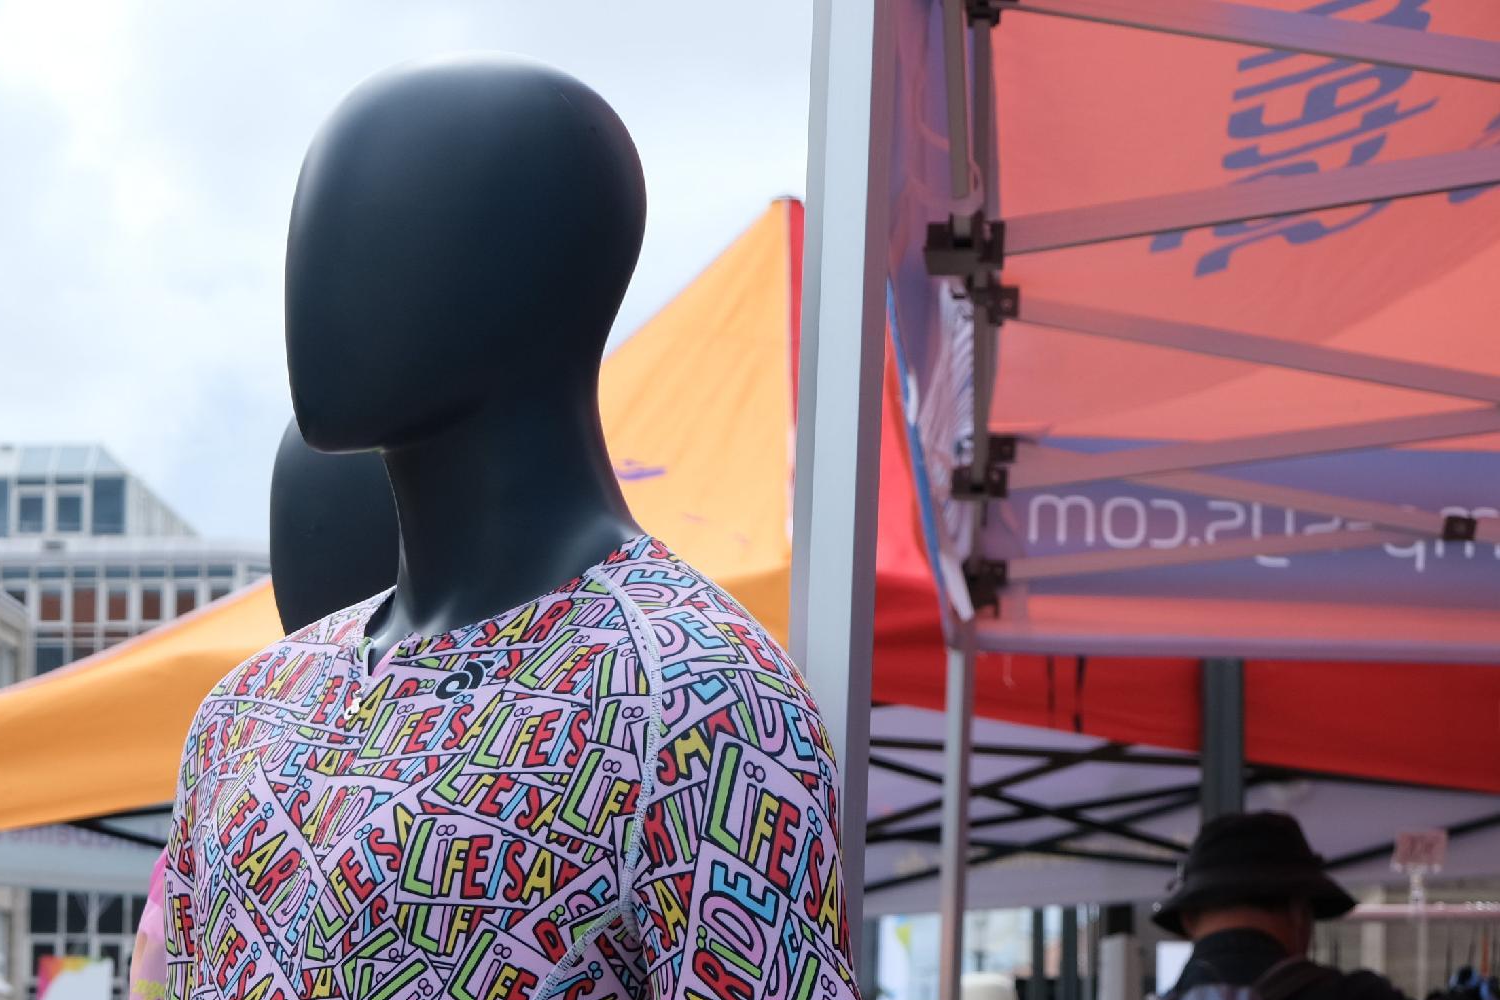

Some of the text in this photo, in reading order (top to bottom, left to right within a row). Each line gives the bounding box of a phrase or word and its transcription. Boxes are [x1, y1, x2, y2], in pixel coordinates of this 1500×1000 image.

[490, 603, 538, 645] A
[238, 832, 288, 887] A
[522, 847, 554, 905] A
[818, 857, 840, 945] A
